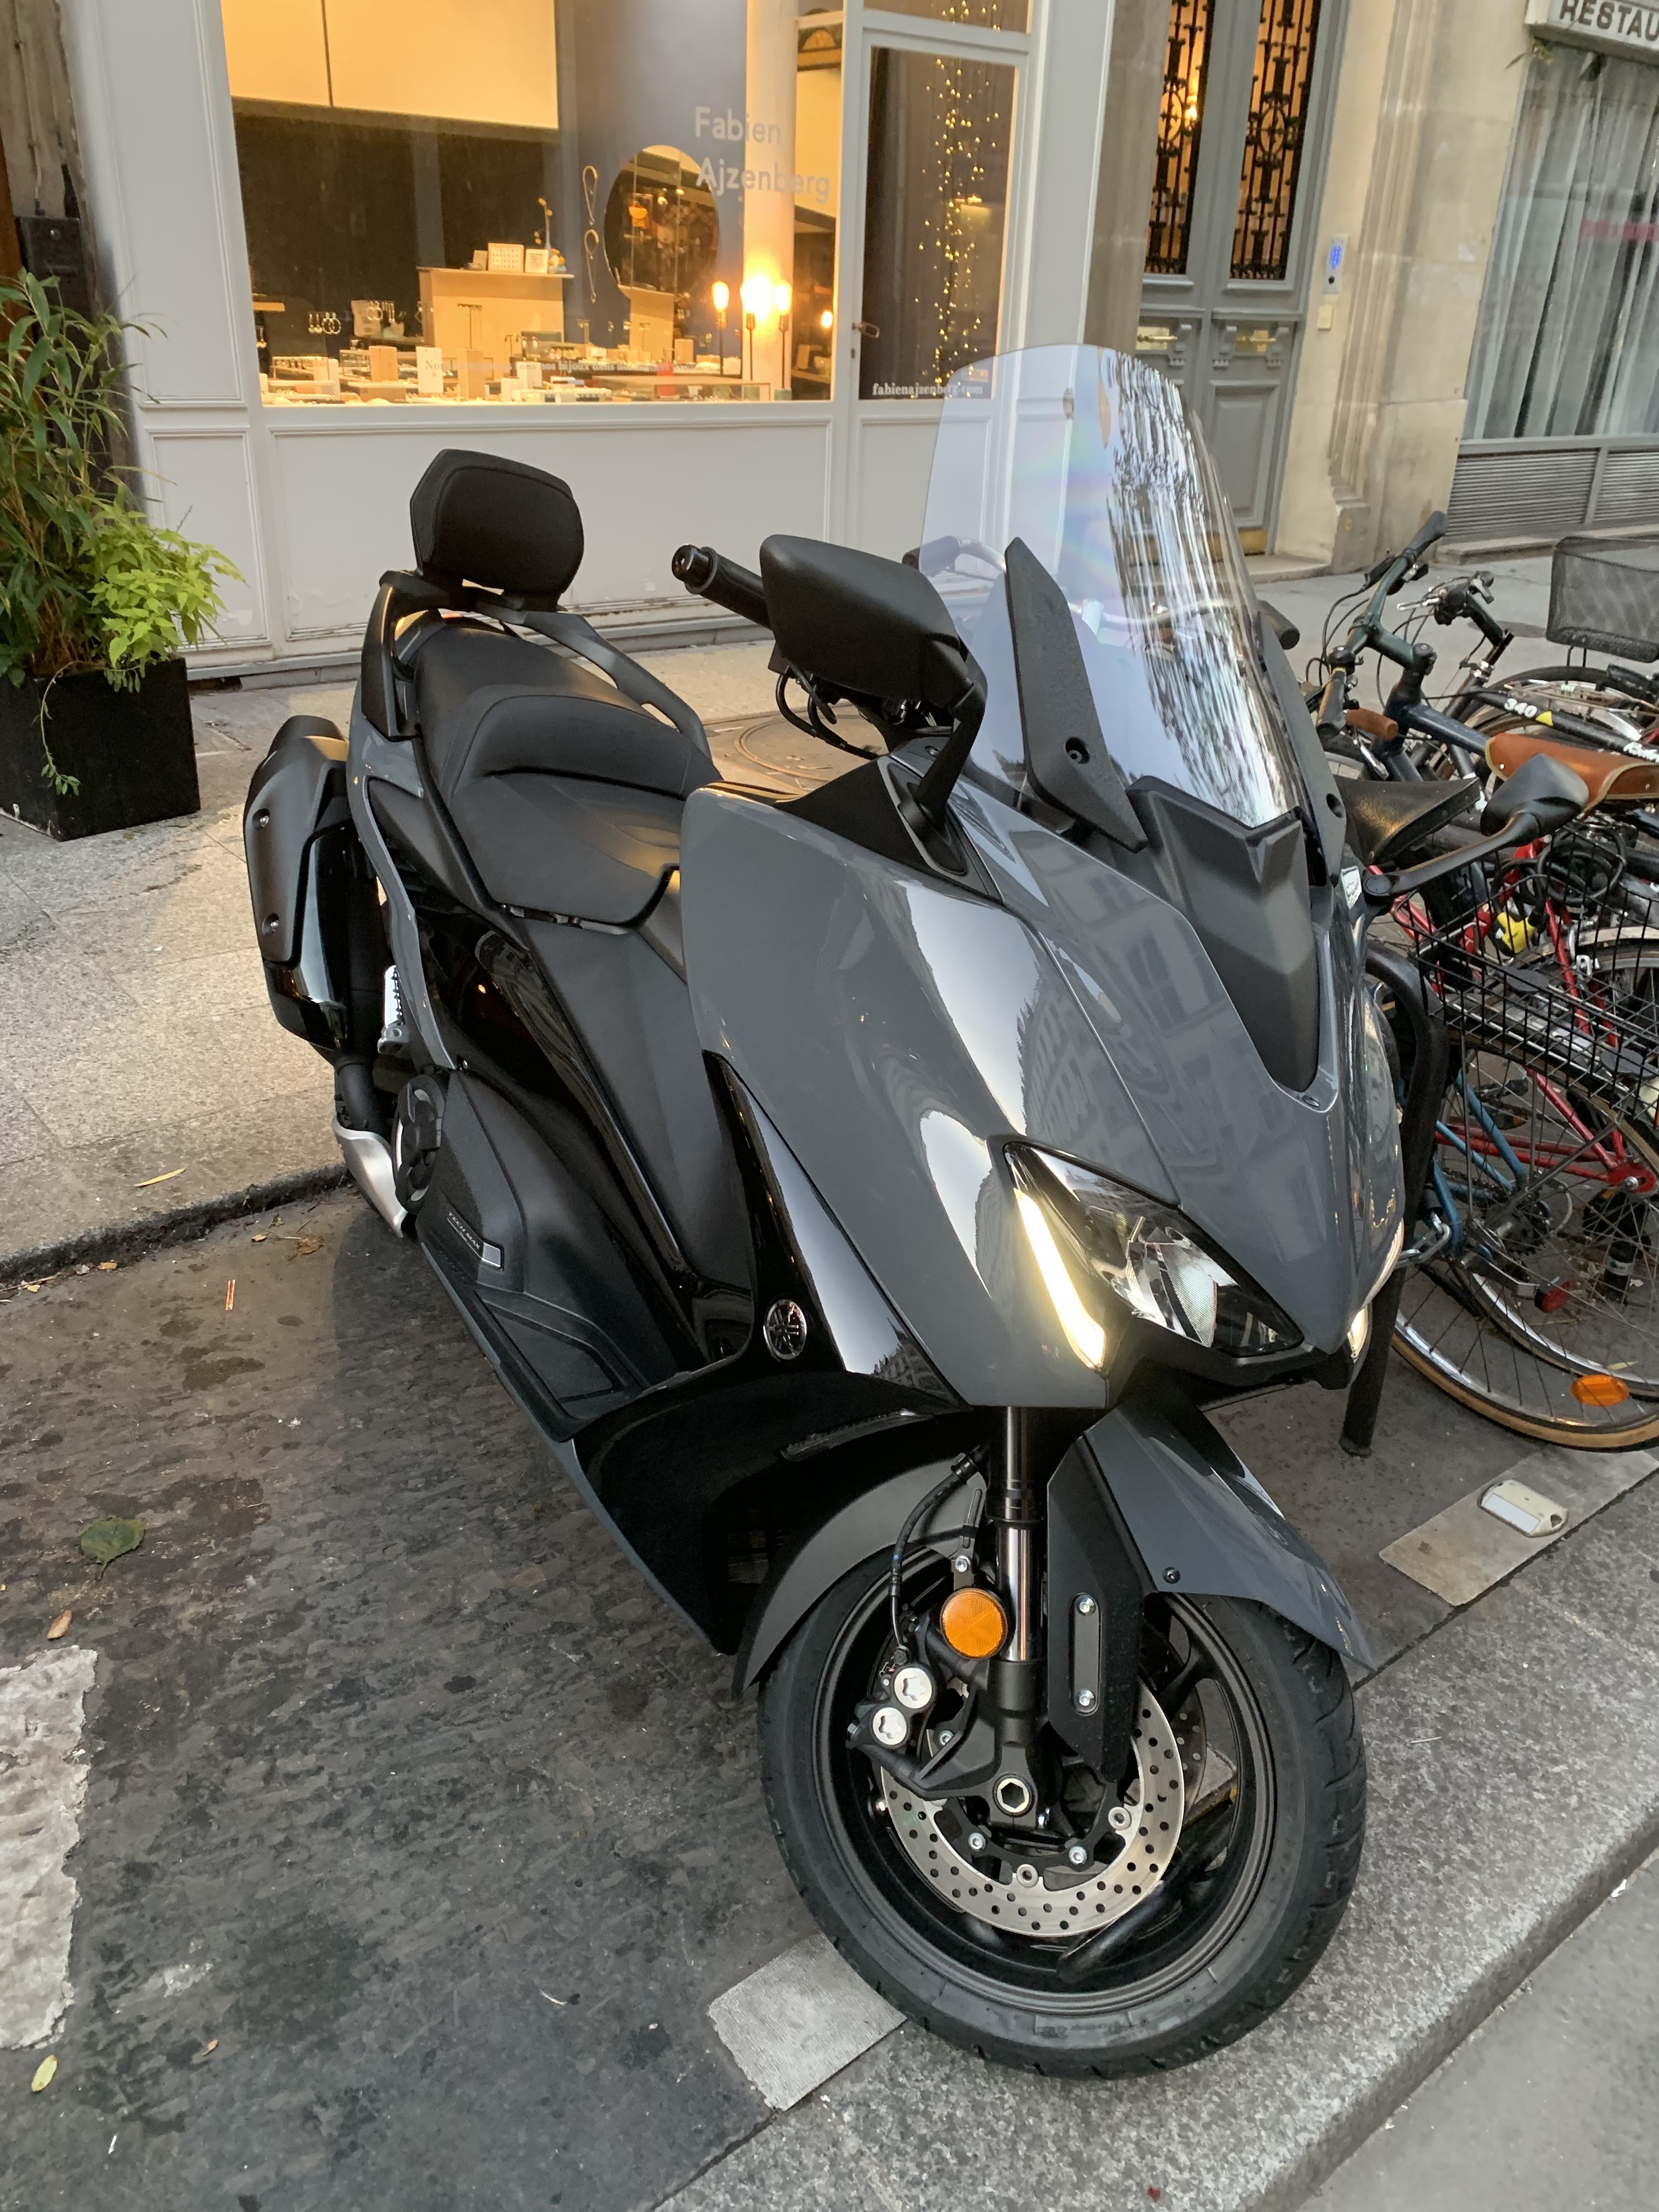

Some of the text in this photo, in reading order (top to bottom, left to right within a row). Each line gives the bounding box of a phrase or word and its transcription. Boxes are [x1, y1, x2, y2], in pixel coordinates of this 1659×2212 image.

[695, 106, 781, 145] Fabien
[695, 156, 830, 204] Ajzenberg
[558, 358, 590, 373] bijoux
[872, 382, 984, 398] fabienajzenberg.com
[1504, 698, 1538, 719] 340
[448, 1210, 481, 1250] TECH MAX
